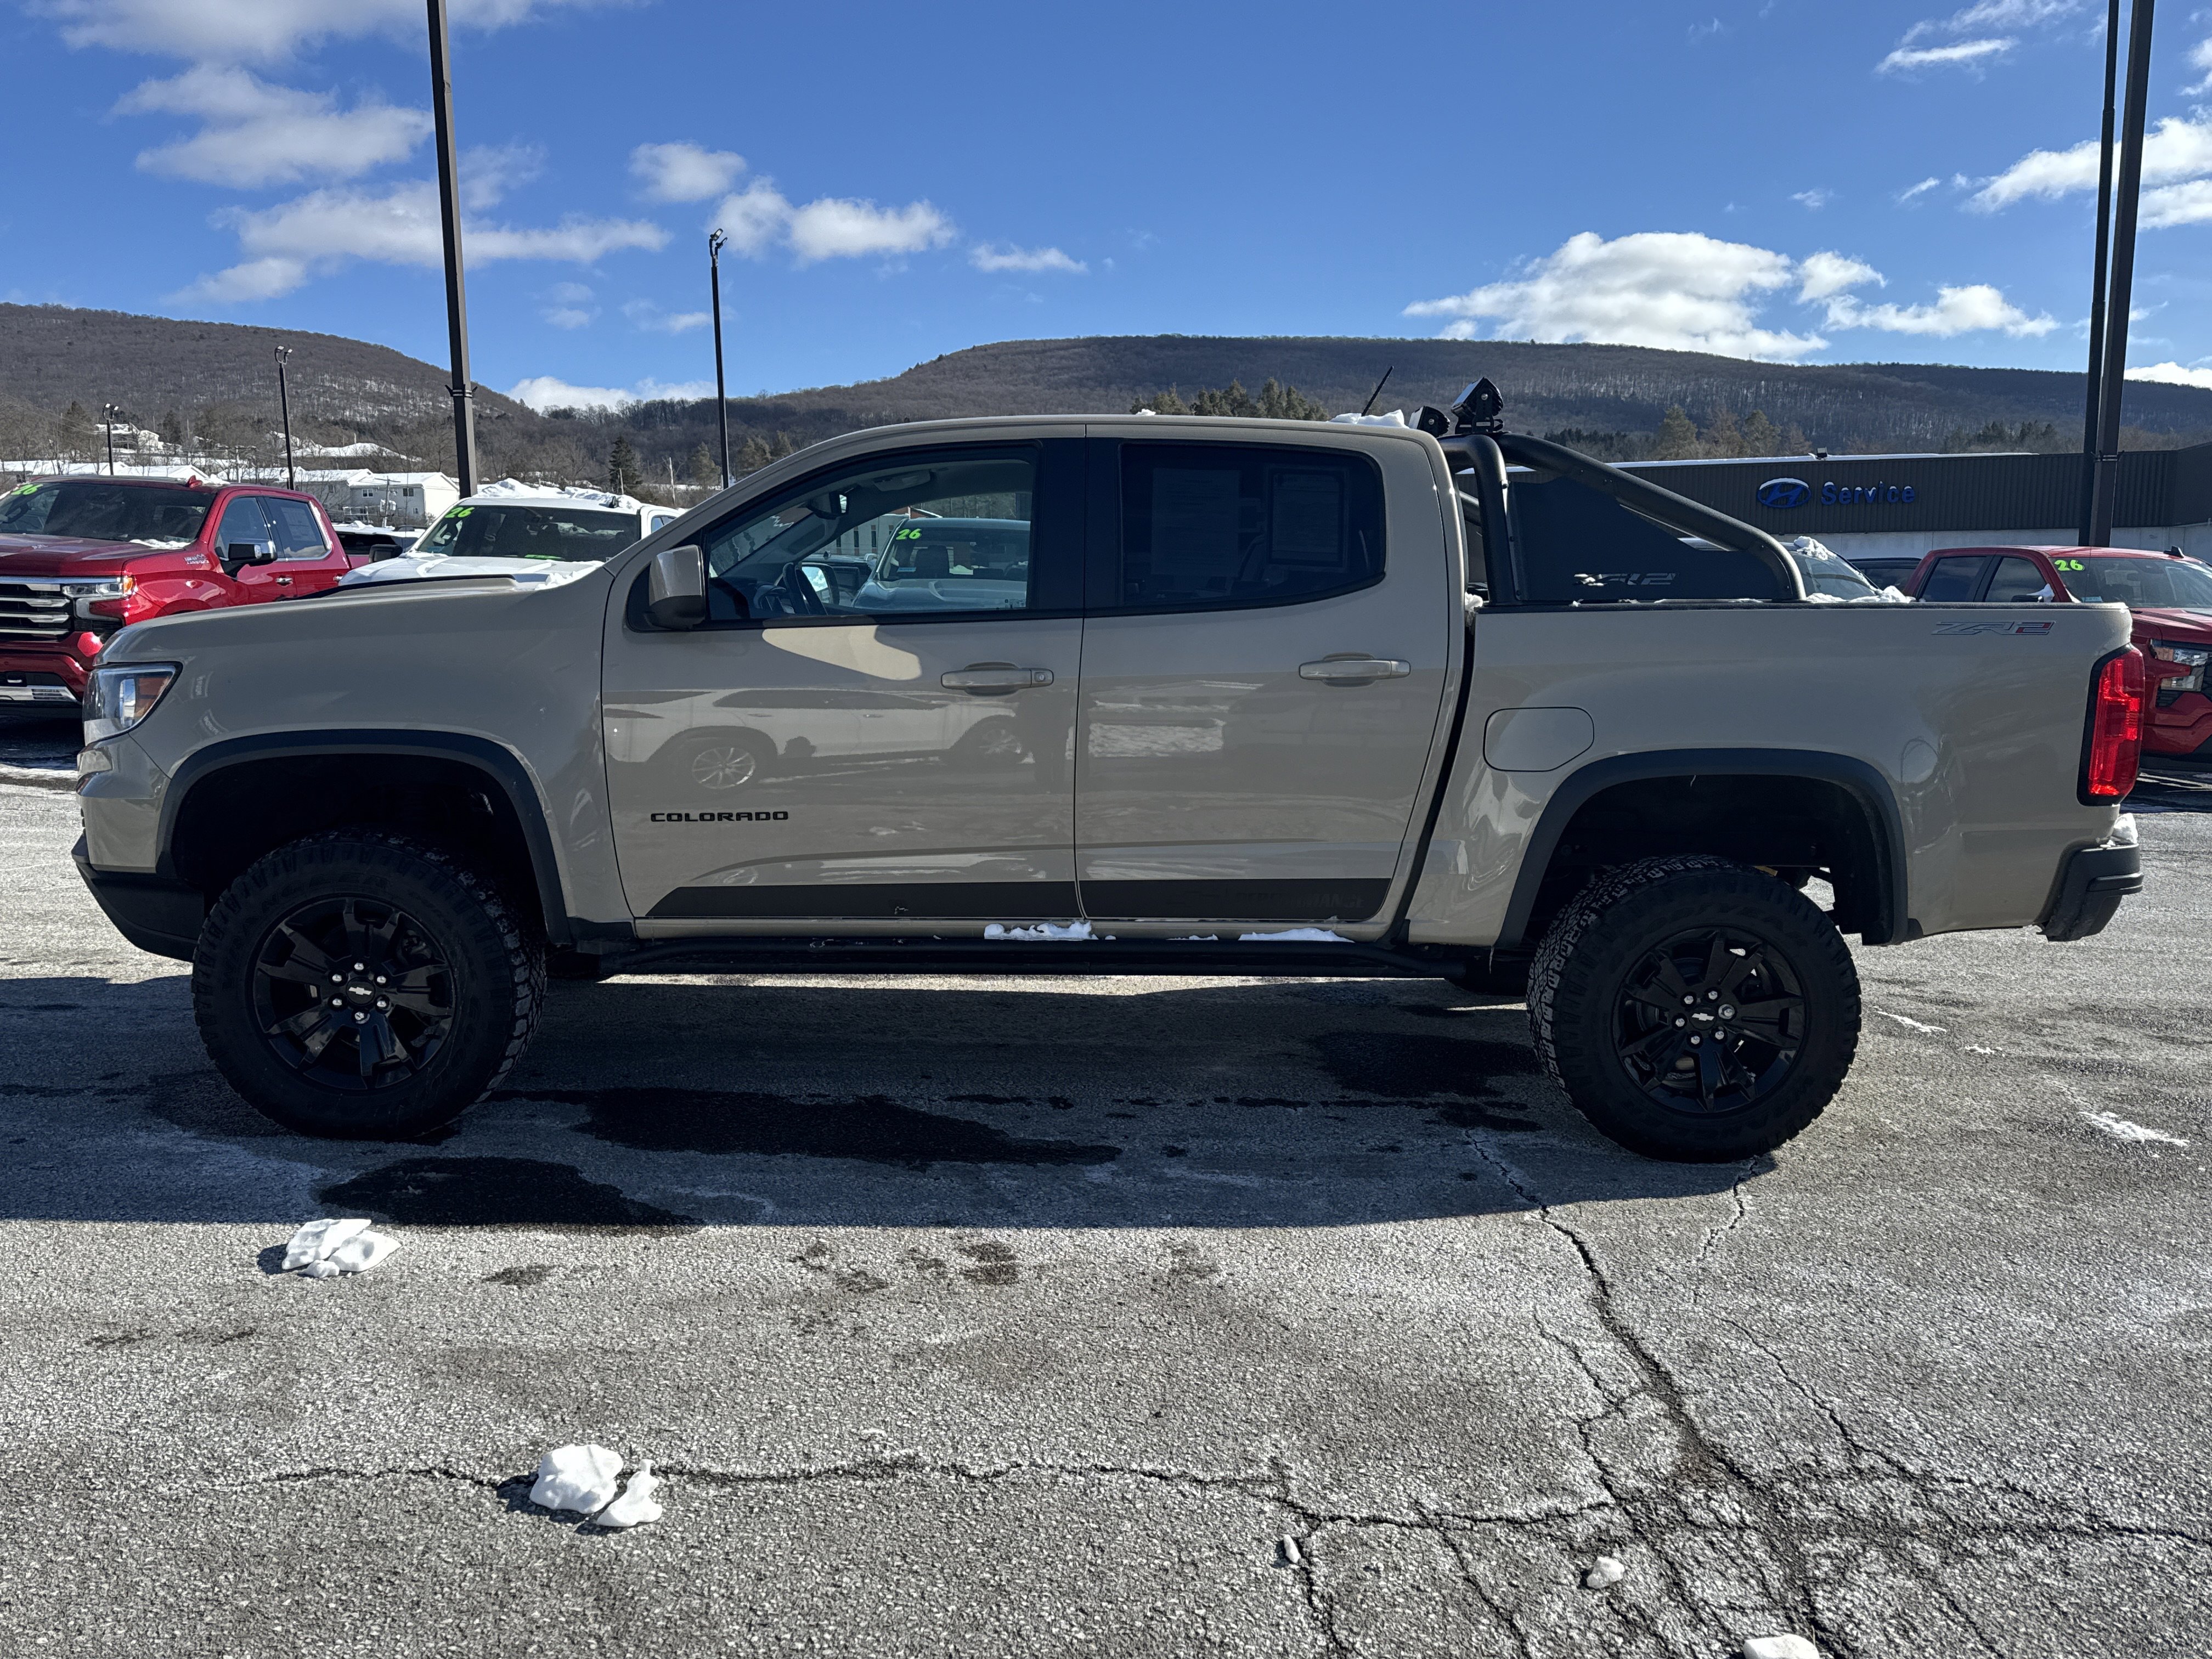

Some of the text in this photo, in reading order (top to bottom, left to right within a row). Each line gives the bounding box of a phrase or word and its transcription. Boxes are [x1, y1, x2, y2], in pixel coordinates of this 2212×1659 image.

[1821, 481, 1915, 505] Service
[445, 506, 475, 518] 26
[896, 528, 922, 540] 26
[2054, 560, 2085, 571] 26
[1931, 620, 2056, 636] ZR2
[651, 811, 789, 822] COLORADO
